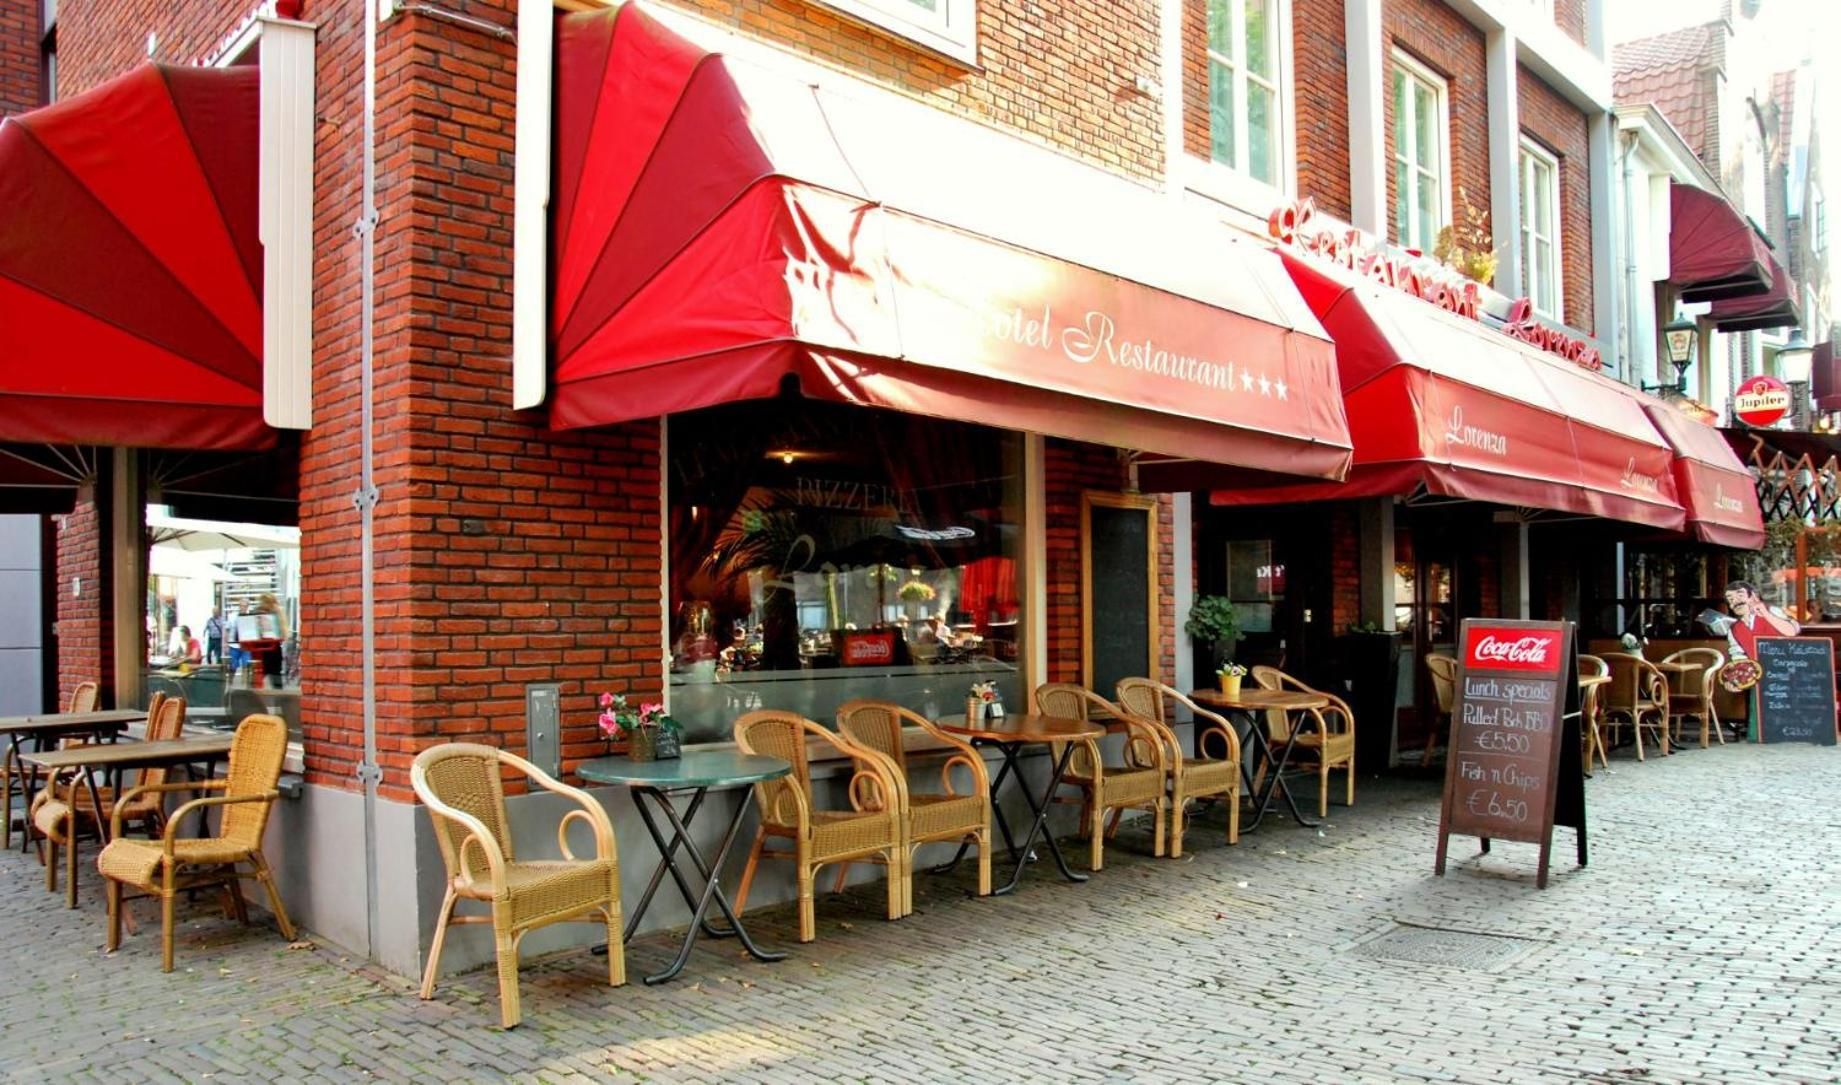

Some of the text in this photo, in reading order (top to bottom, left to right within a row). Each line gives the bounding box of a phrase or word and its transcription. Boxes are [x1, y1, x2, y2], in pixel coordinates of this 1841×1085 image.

[985, 304, 1236, 392] otel Restaurant
[1501, 296, 1602, 372] Lorenza
[1740, 395, 1785, 409] Jupiler
[1445, 405, 1507, 456] Lorenza
[1620, 456, 1658, 492] Lorenza
[1475, 635, 1552, 663] Coca-Cola
[1465, 677, 1551, 705] Lunch specials
[1463, 703, 1498, 726] Pulled
[1474, 730, 1530, 753] €5.50
[1461, 761, 1485, 781] Fish
[1503, 763, 1540, 794] Chips
